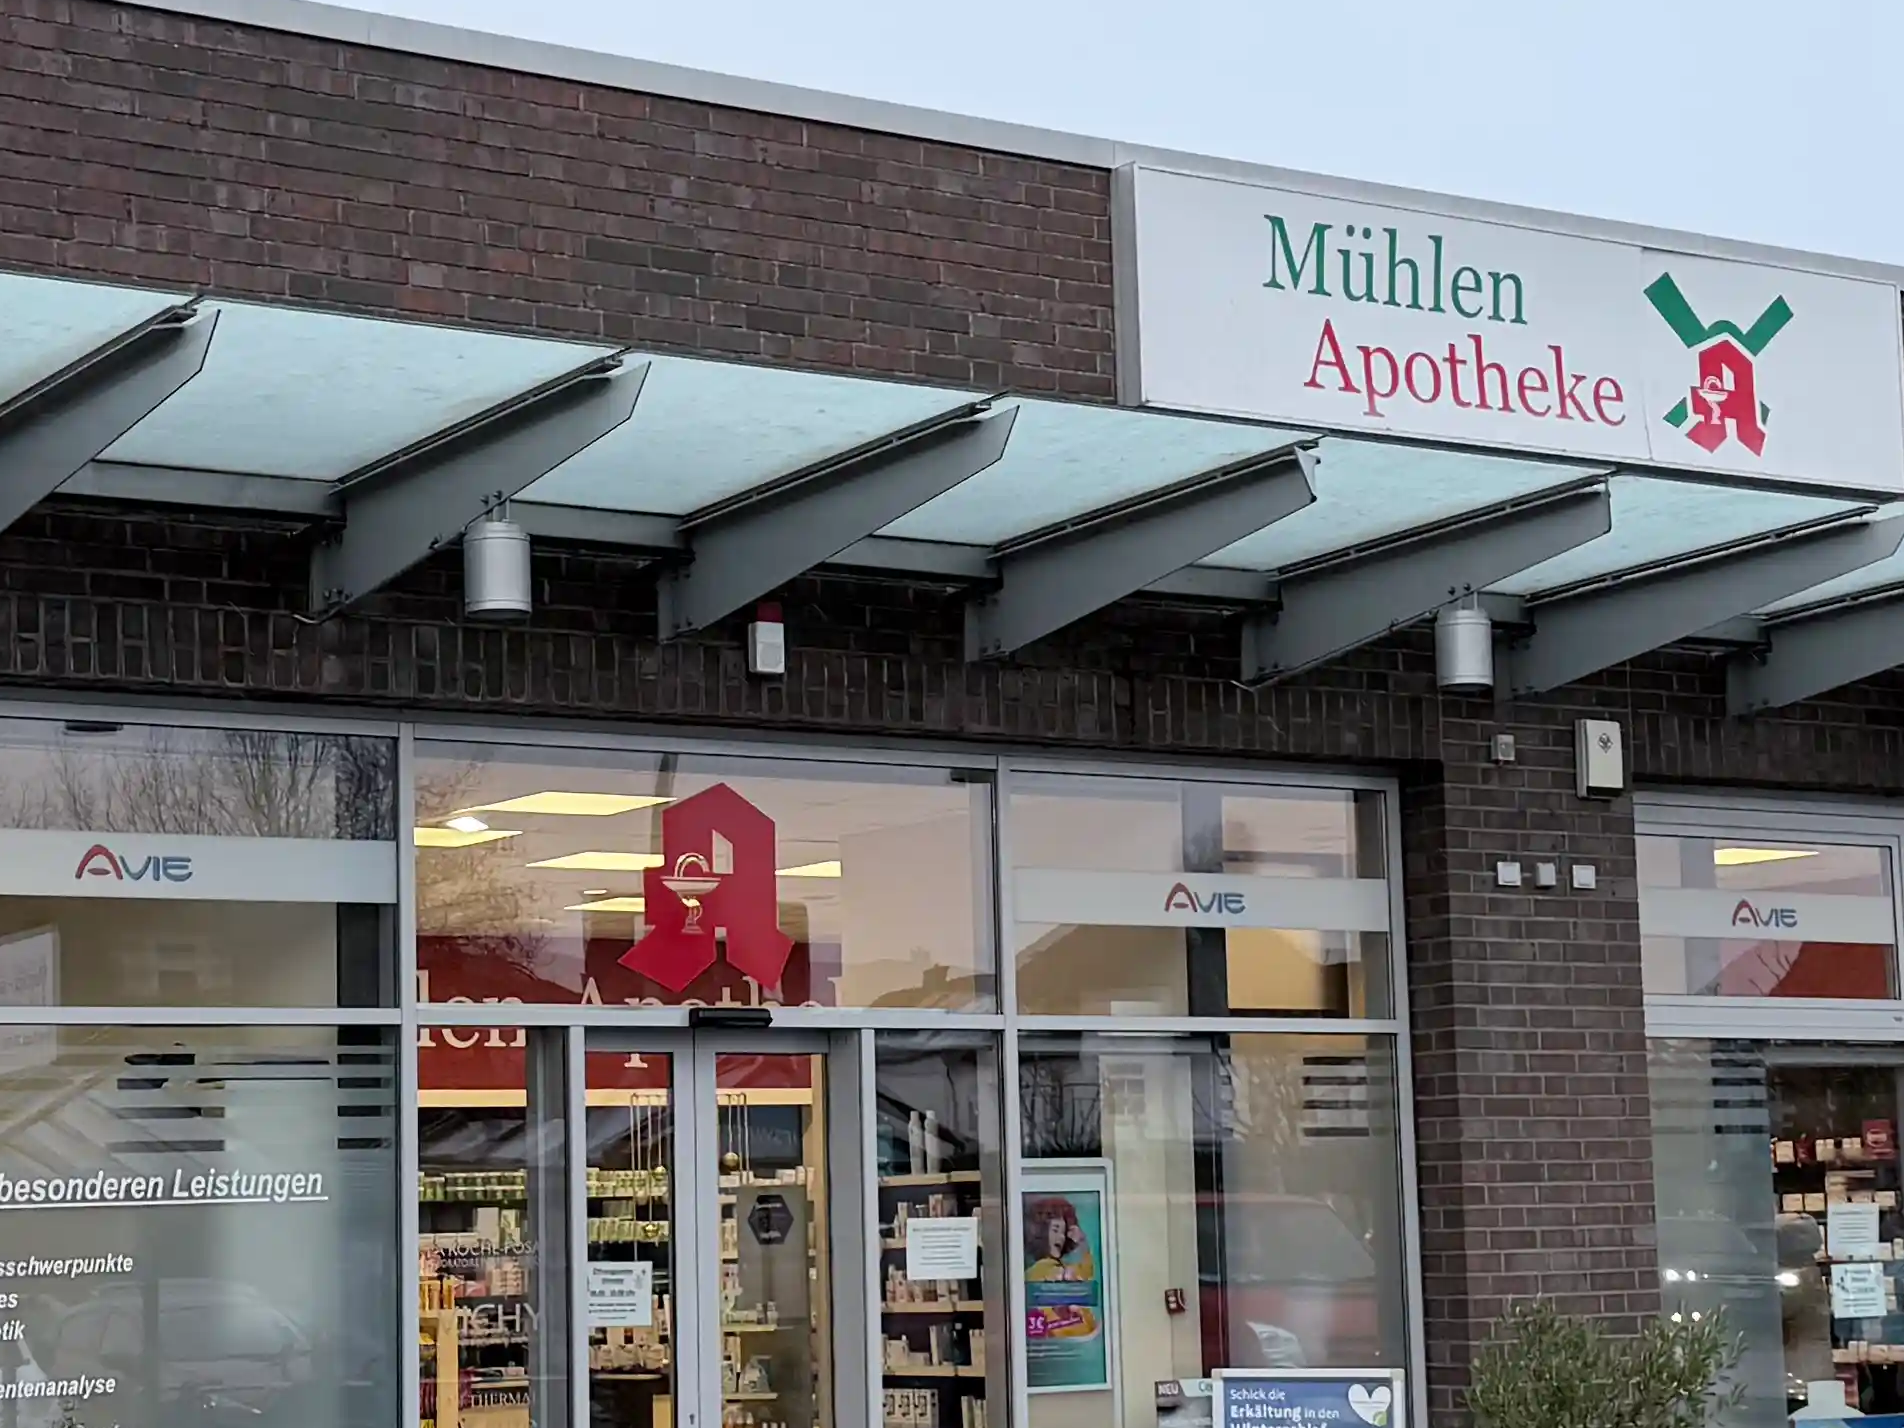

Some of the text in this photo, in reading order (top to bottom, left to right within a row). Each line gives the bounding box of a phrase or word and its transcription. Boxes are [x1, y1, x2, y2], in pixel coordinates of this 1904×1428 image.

[1263, 214, 1527, 325] Mühlen
[1304, 318, 1627, 427] Apotheke
[173, 1167, 324, 1203] Leistungen
[1158, 1383, 1179, 1395] NEU
[1229, 1387, 1286, 1400] Schick die
[1230, 1403, 1340, 1422] Erkältung in den
